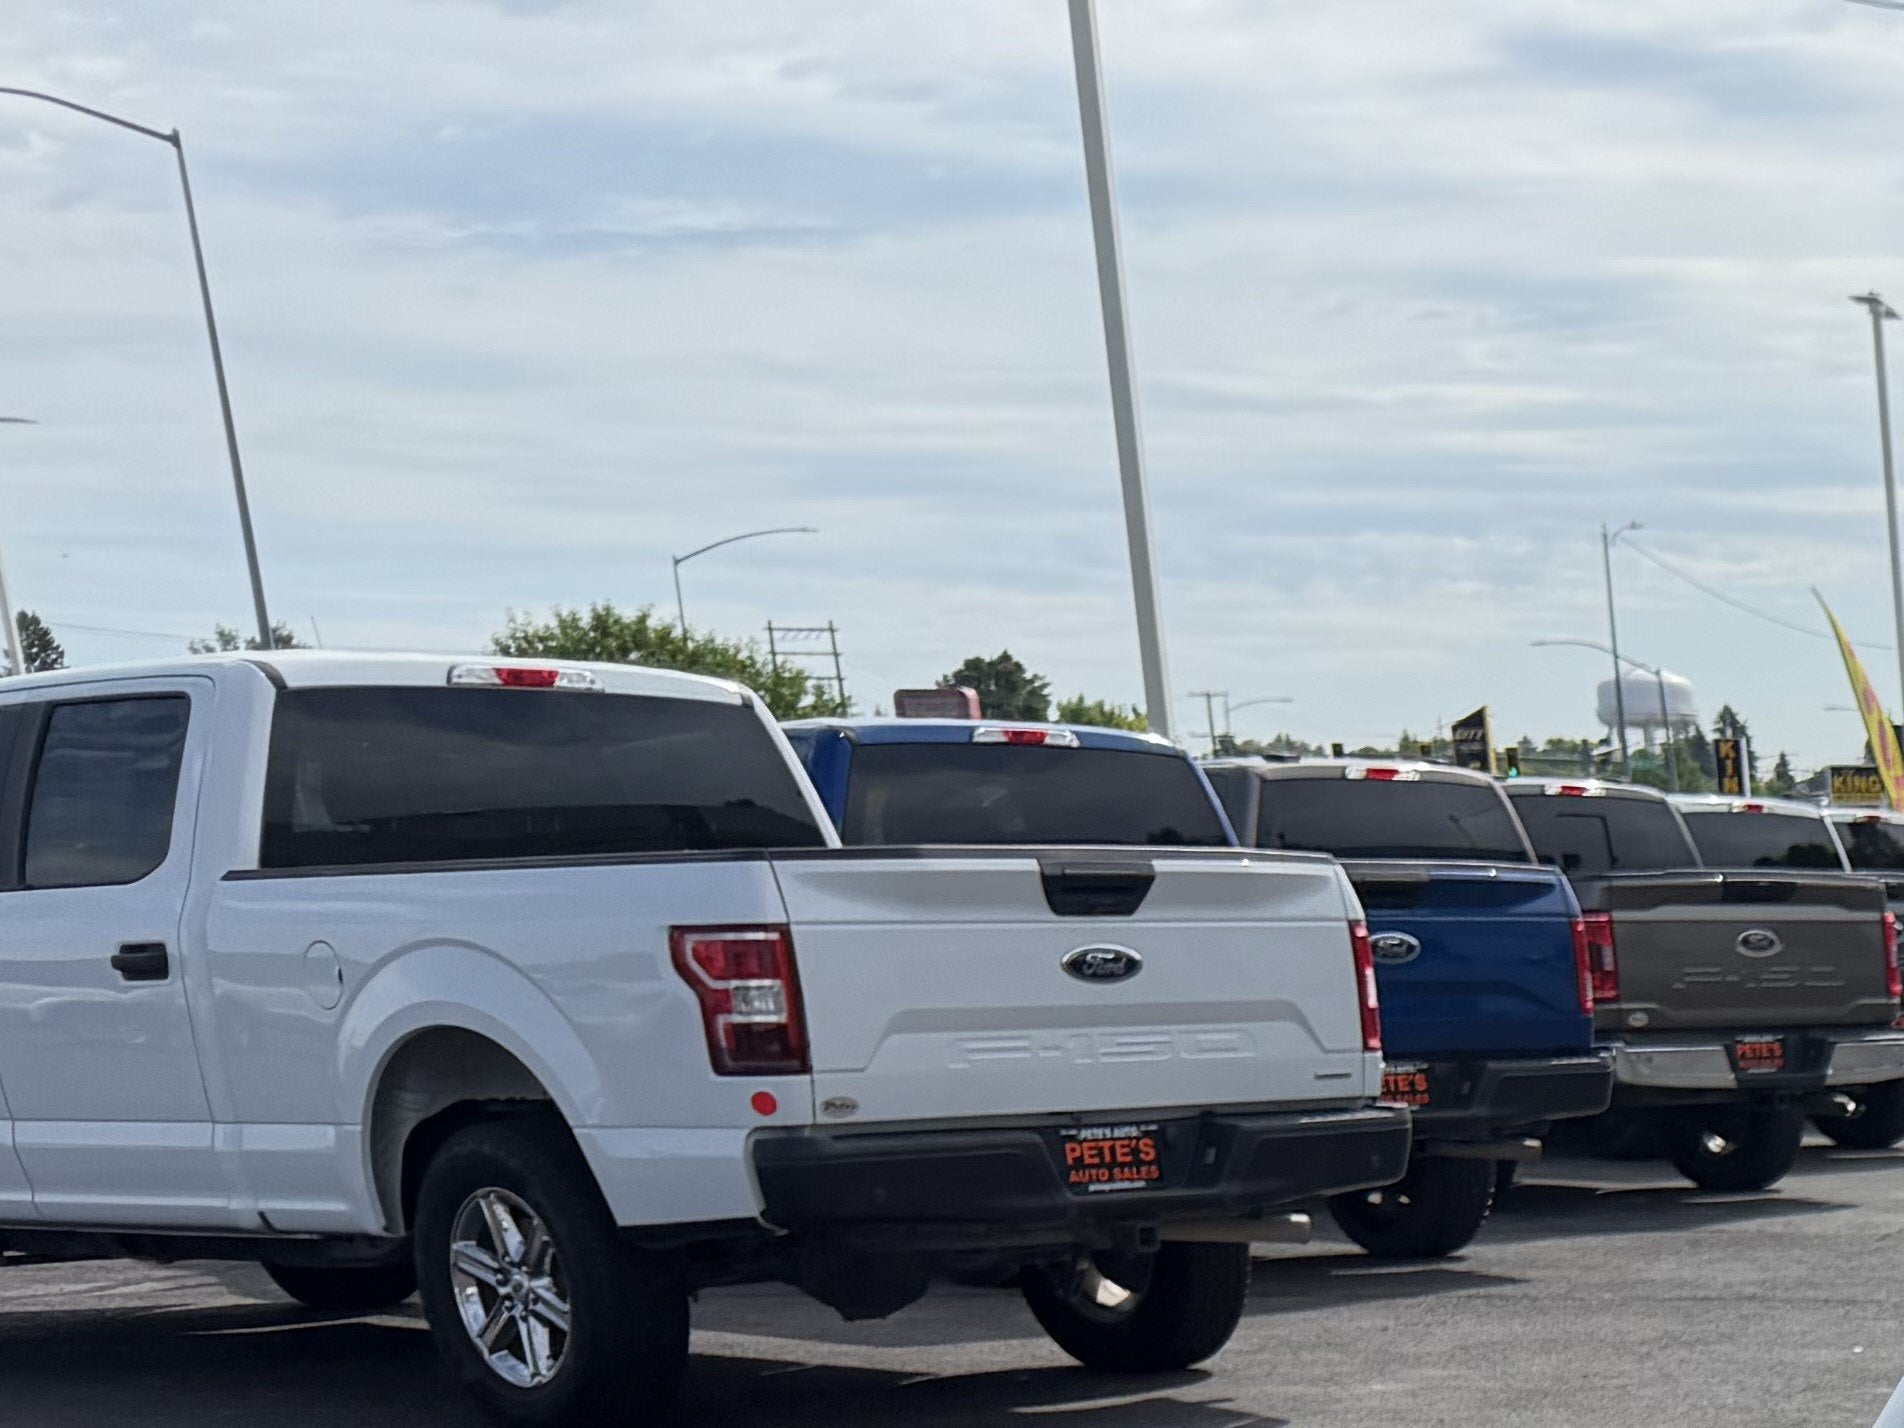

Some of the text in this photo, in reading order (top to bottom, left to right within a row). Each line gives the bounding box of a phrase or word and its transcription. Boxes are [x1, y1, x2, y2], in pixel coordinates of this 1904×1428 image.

[946, 1028, 1257, 1069] F-150
[1064, 1137, 1156, 1166] PETE'S
[1068, 1164, 1160, 1184] AUTO SALES
